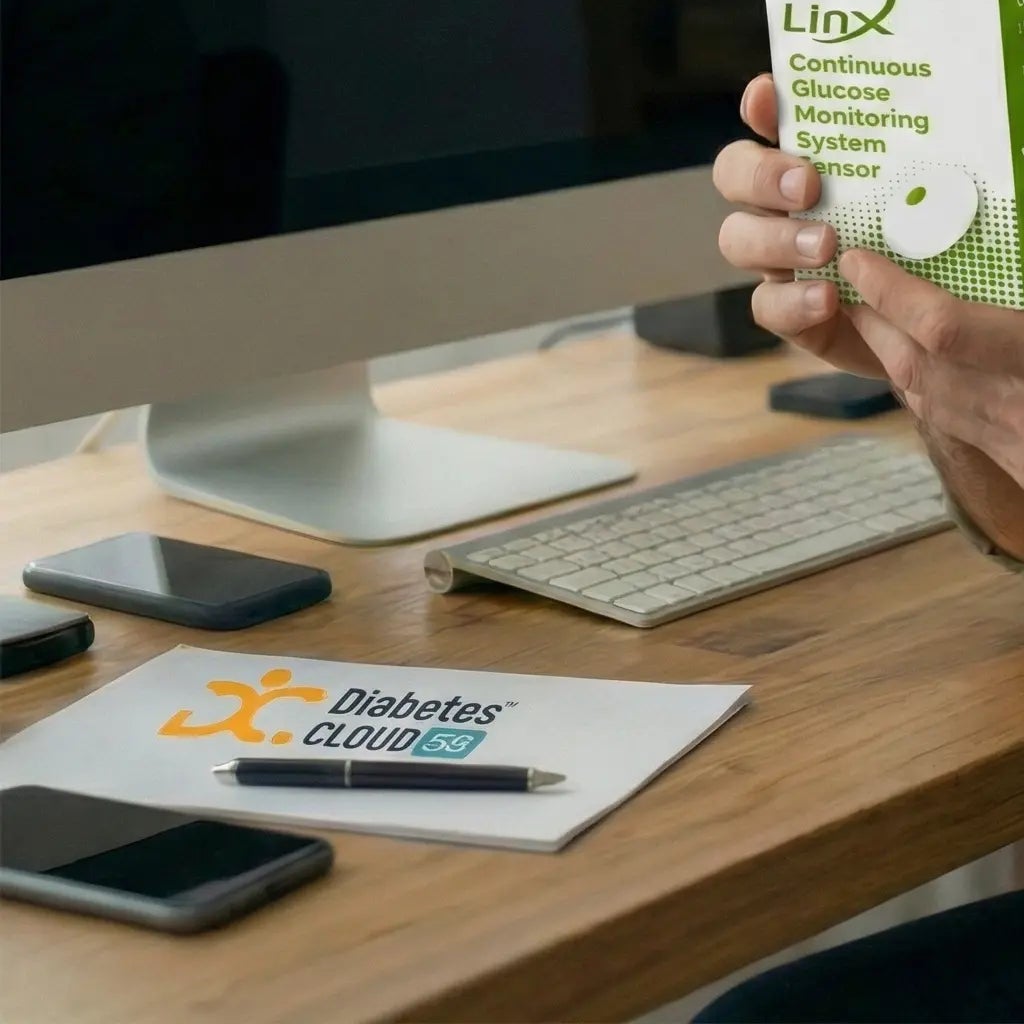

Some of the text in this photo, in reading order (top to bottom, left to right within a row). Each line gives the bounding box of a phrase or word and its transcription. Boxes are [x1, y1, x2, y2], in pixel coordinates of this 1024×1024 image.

[789, 53, 932, 77] Continuous
[791, 79, 891, 101] Glucose
[794, 104, 929, 134] Monitoring
[796, 131, 886, 154] System
[800, 155, 881, 178] ensor
[302, 721, 421, 752] CLOUD
